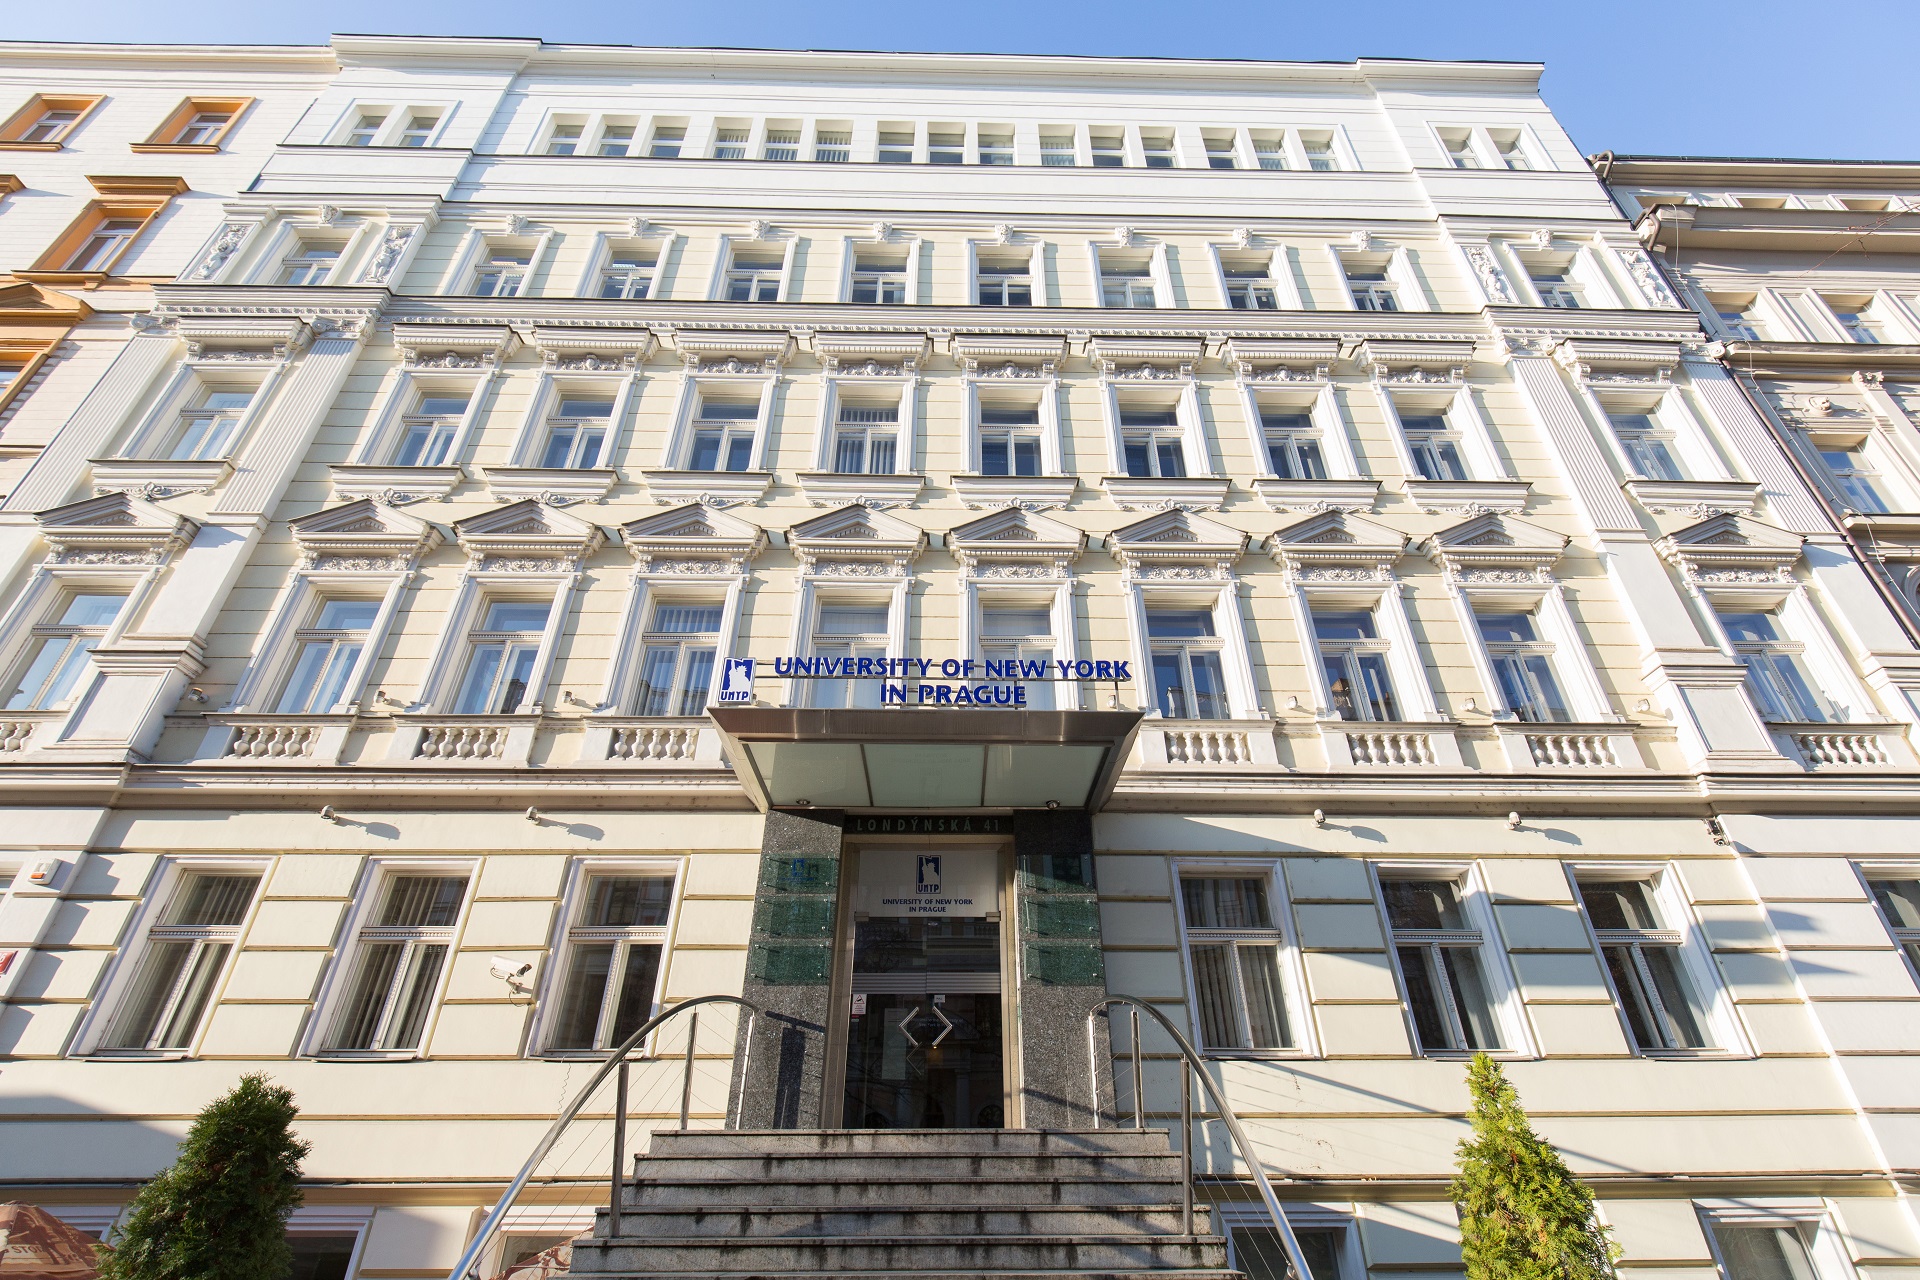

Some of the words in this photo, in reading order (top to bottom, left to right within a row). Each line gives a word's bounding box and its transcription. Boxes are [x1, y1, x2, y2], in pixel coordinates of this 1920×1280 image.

[774, 656, 932, 677] UNIVERSITY
[941, 658, 975, 678] OF
[985, 659, 1047, 678] NEW
[1056, 660, 1132, 679] YORK
[720, 691, 749, 701] UNYP
[880, 683, 907, 703] IN
[918, 684, 1027, 704] PRAGUE
[857, 816, 971, 832] LONDÝNSKÁ
[984, 819, 999, 832] 41
[917, 884, 940, 893] UNYP
